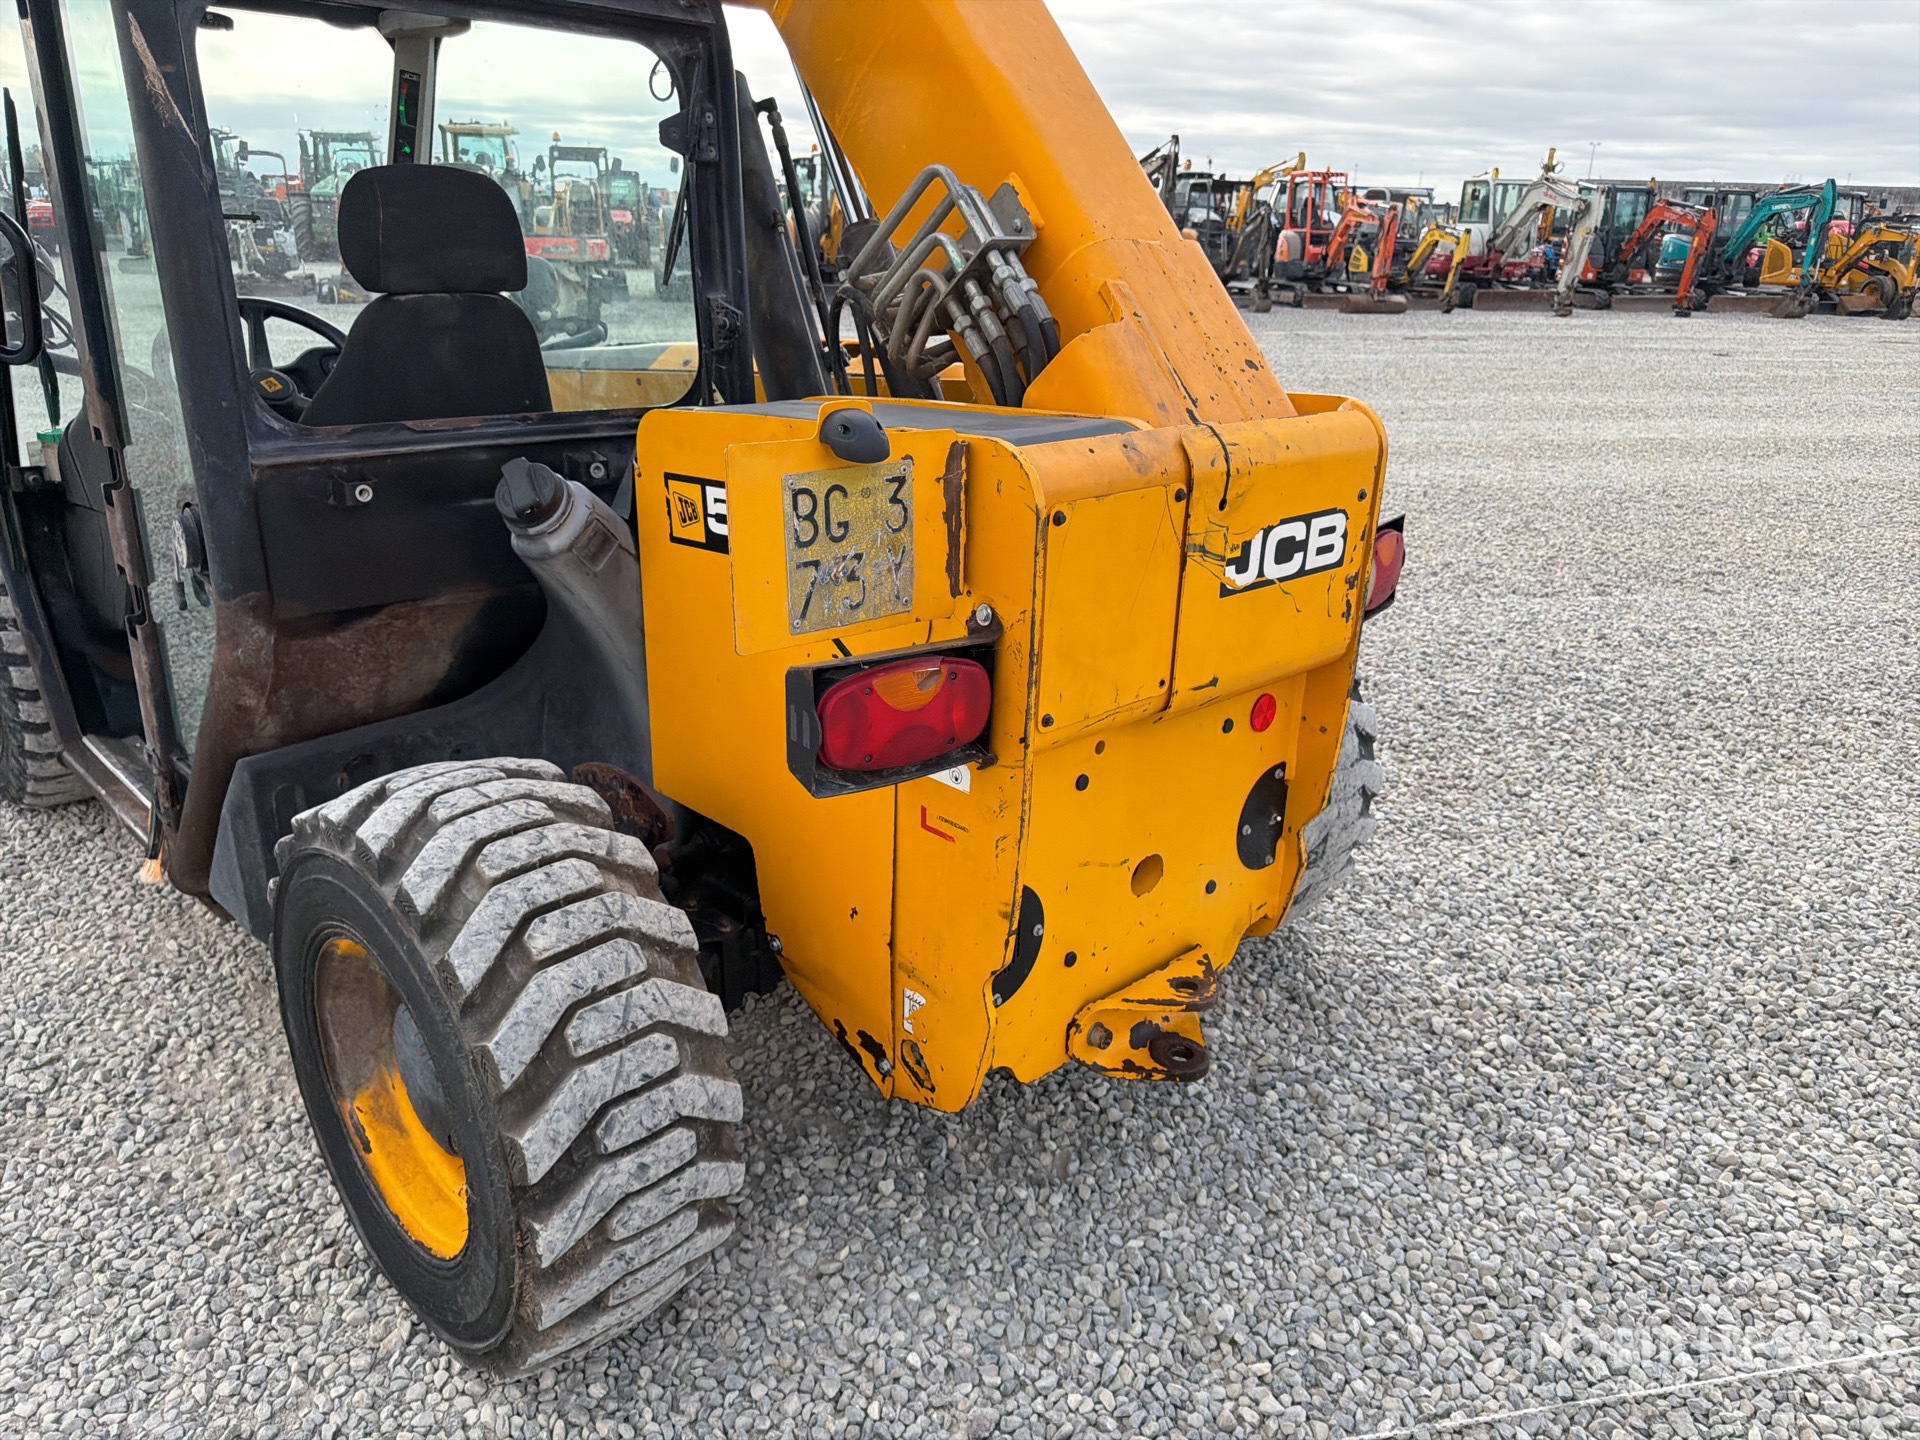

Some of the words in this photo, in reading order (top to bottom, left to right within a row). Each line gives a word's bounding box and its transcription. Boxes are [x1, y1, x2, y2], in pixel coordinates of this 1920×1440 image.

[677, 496, 699, 525] JCB
[792, 484, 850, 549] BG
[884, 475, 909, 534] 3
[1224, 512, 1347, 590] JCB
